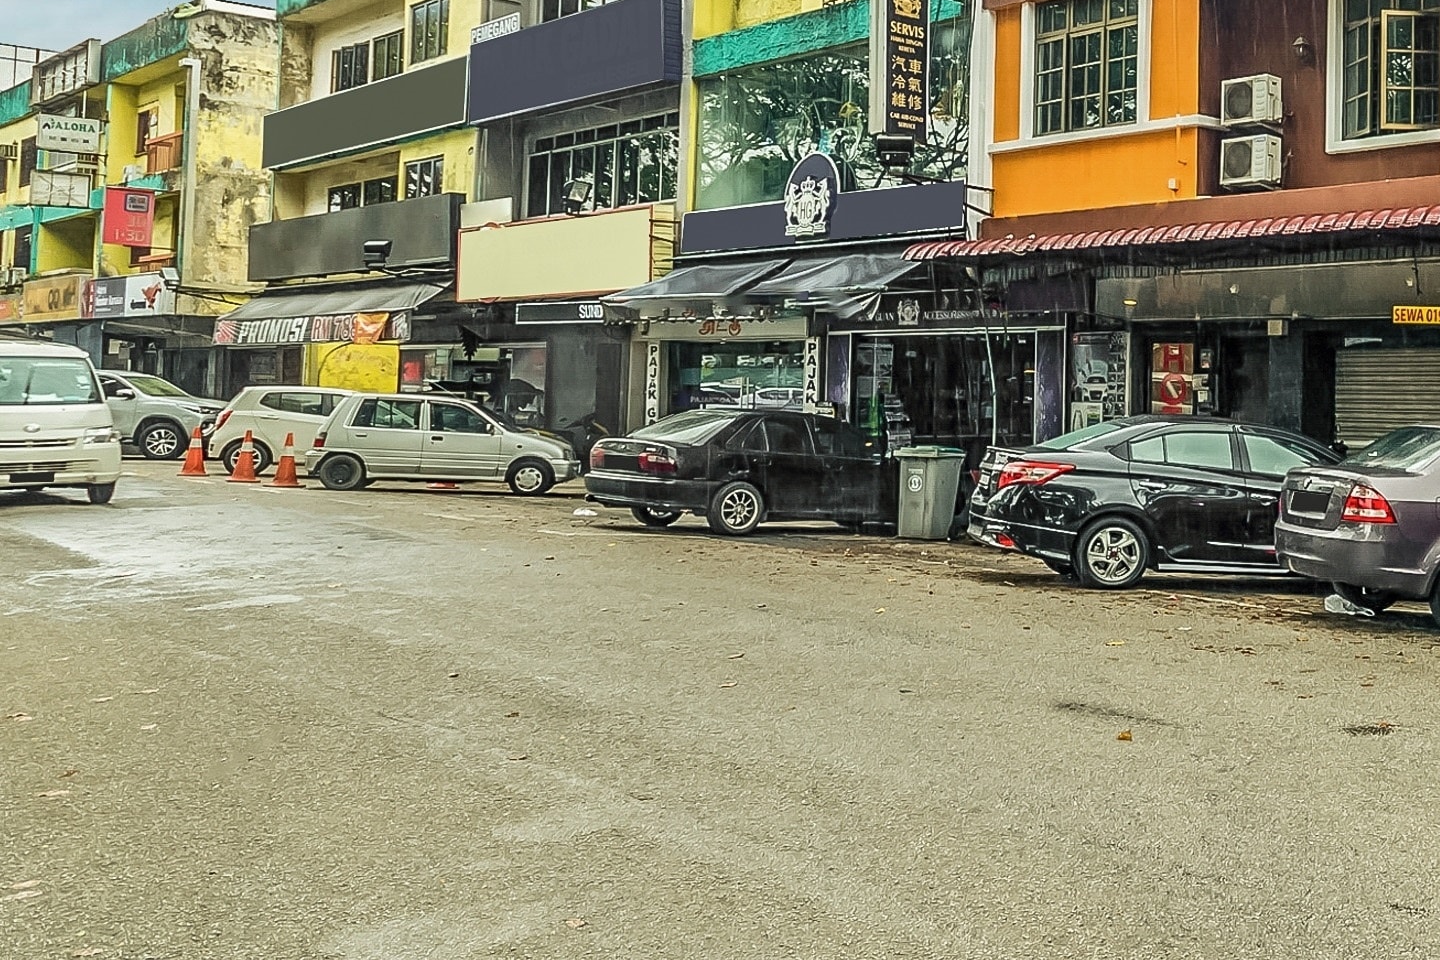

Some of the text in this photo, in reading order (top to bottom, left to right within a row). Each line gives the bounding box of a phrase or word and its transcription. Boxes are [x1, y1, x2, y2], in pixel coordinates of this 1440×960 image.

[890, 20, 925, 39] SERVIS
[55, 121, 96, 133] ALOHA
[1394, 308, 1424, 323] SEWA
[237, 316, 310, 344] PROMOSI
[647, 345, 658, 400] PAJAK
[805, 342, 817, 404] PAJAK
